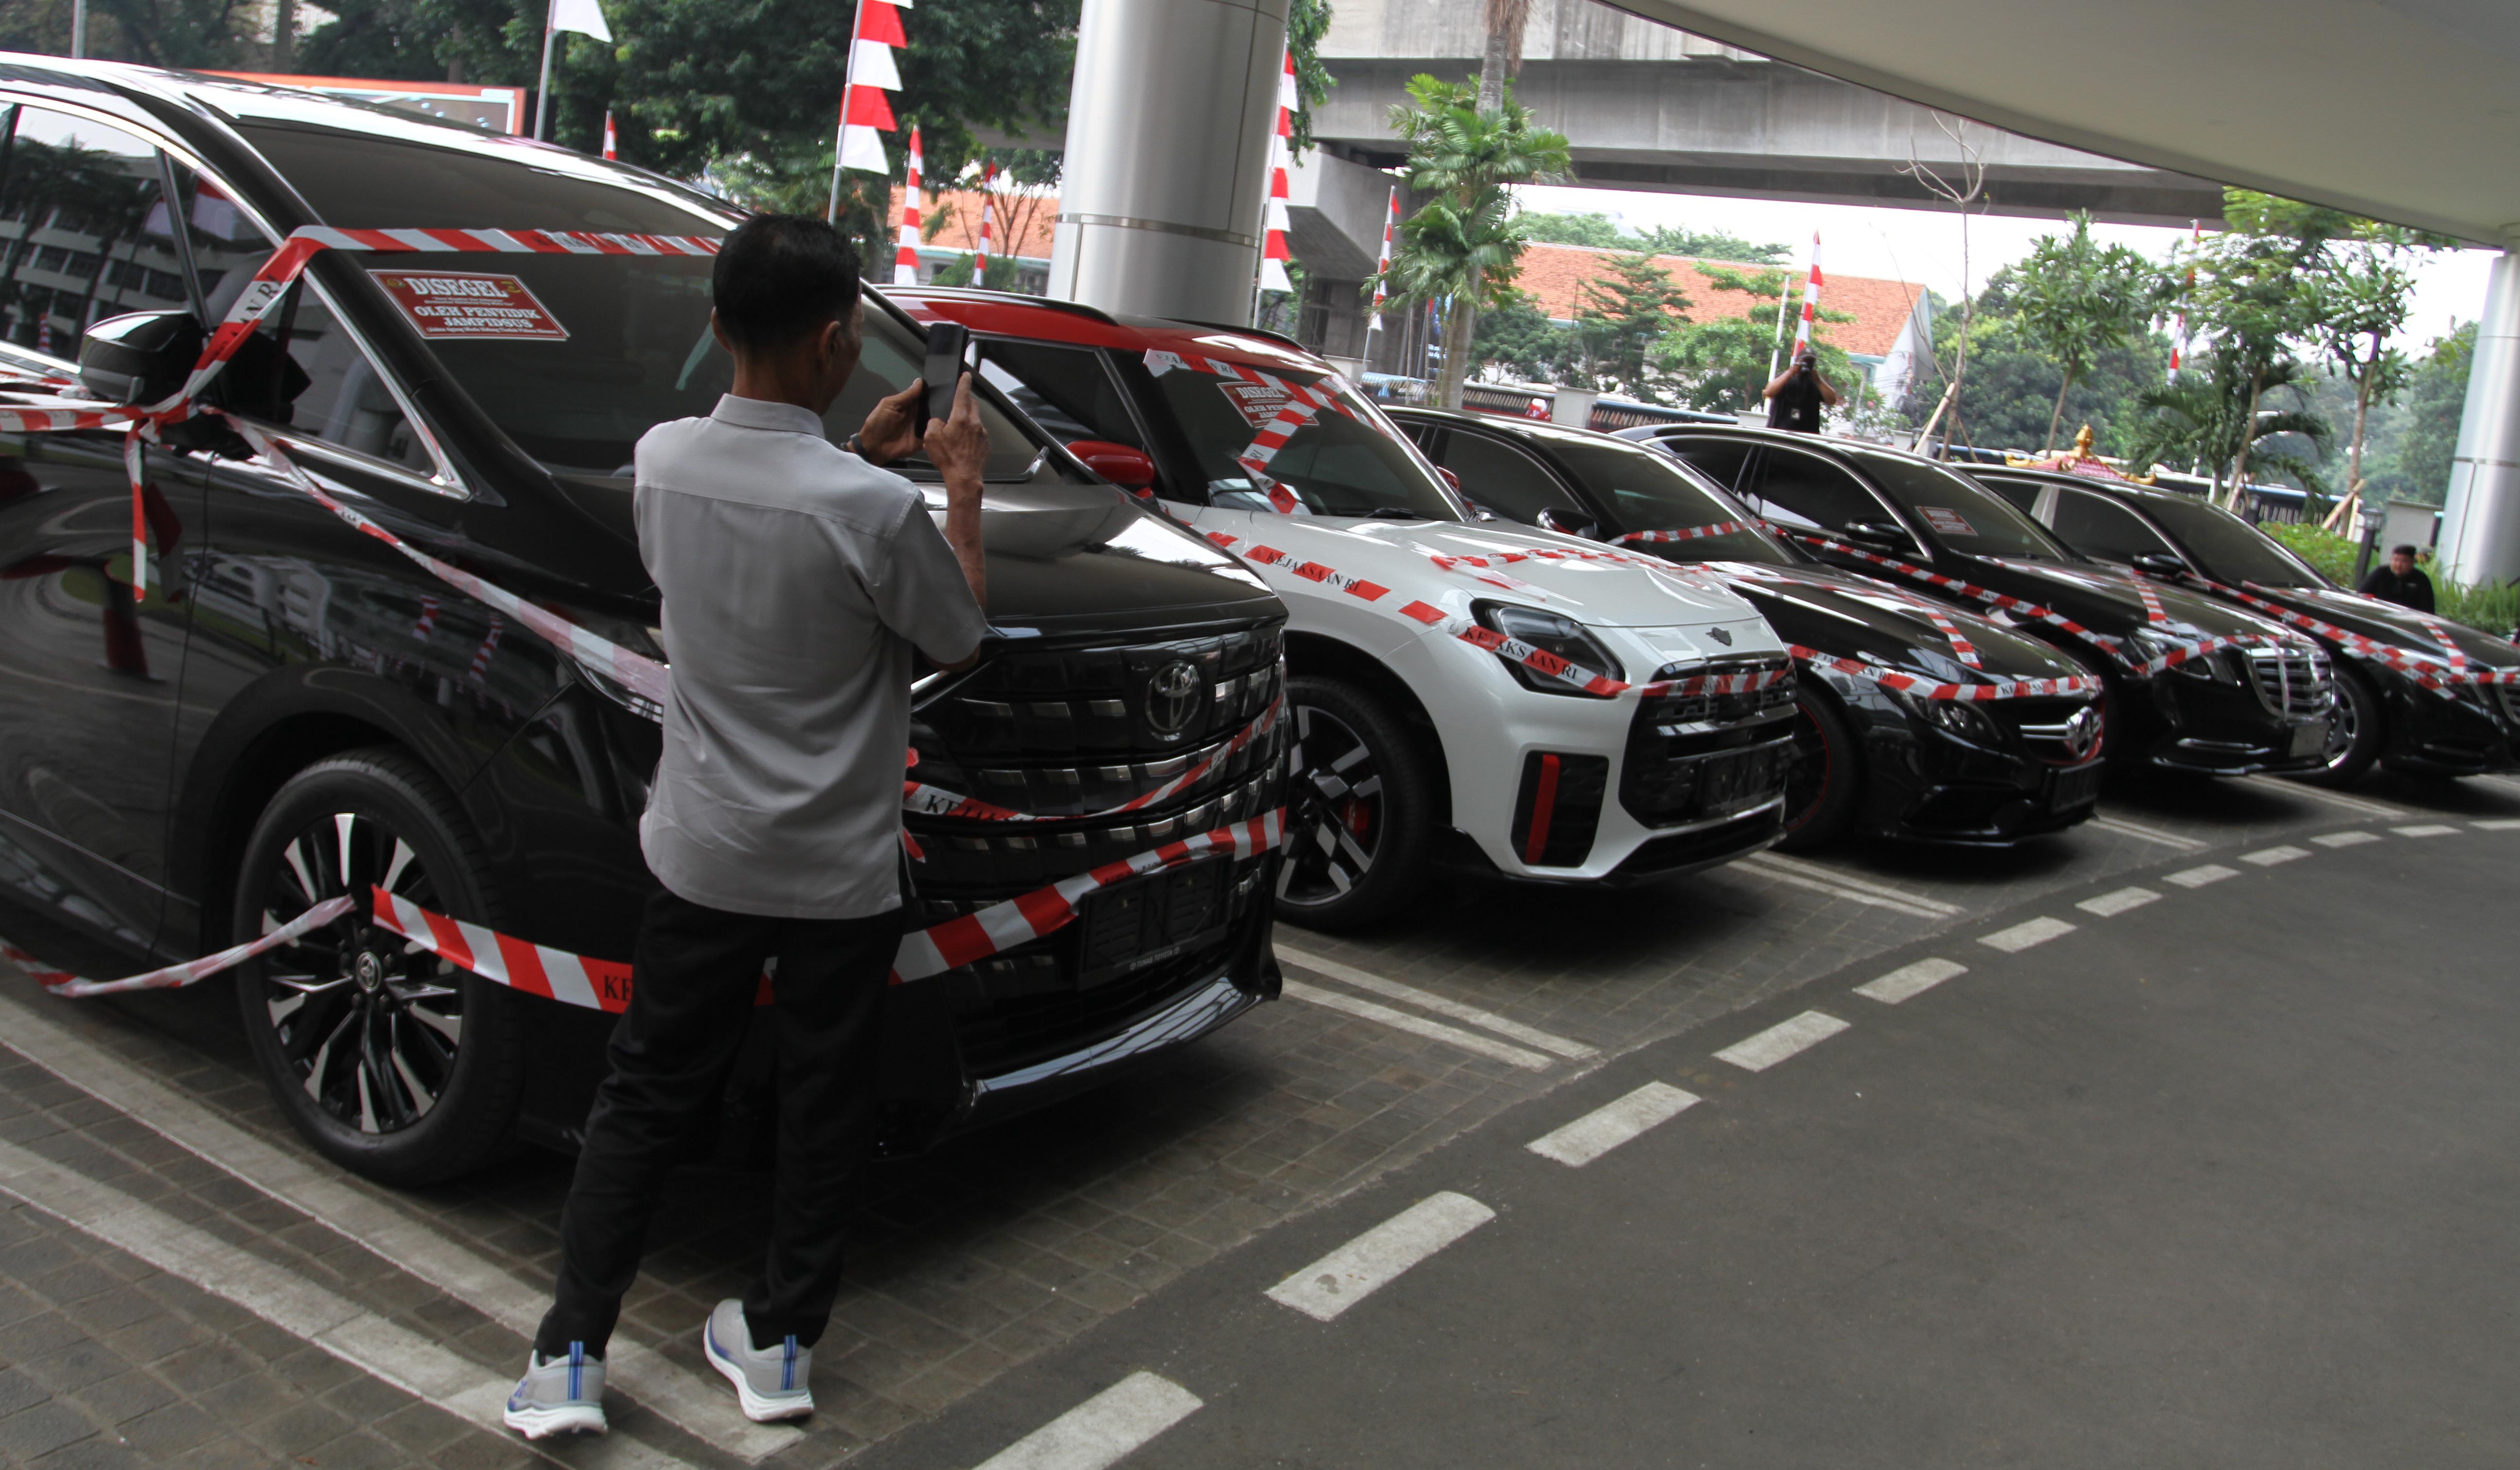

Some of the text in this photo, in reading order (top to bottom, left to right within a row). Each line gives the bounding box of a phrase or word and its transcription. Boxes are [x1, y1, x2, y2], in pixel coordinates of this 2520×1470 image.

[403, 278, 510, 298] DISEGEL
[414, 305, 542, 319] OLEH PENYIDIK
[444, 317, 534, 328] JAMPIDSUS
[1220, 365, 1233, 374] RI
[1235, 386, 1285, 398] DISEGEL
[1250, 449, 1264, 461] RI
[1266, 552, 1361, 592] KEJAKSAAN RI
[1464, 626, 1577, 679] KEJAKSAAN RI
[1137, 949, 1172, 968] TUNAS TOYOTA
